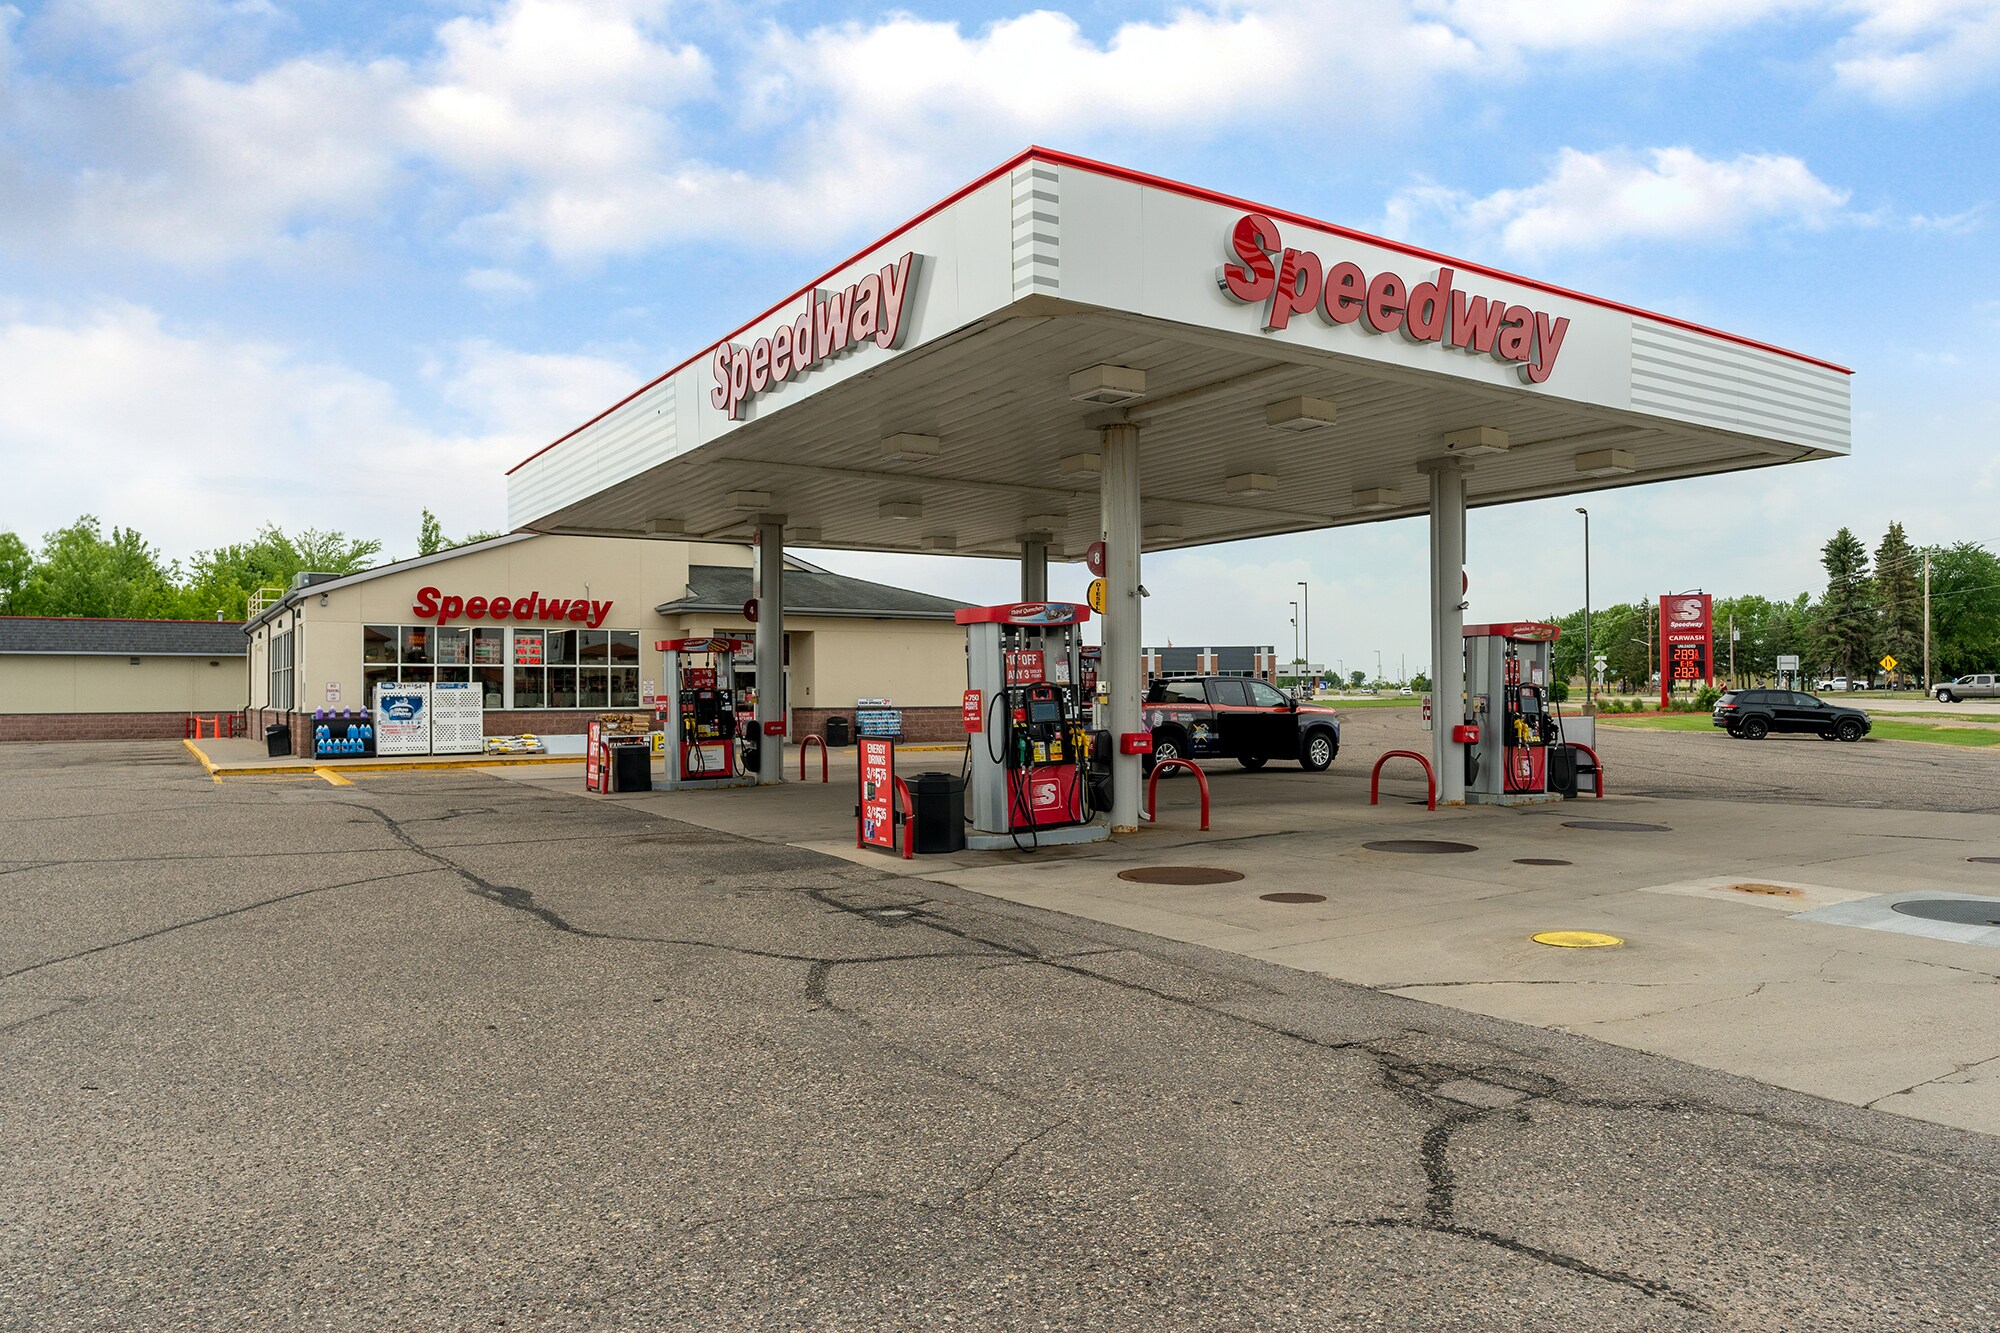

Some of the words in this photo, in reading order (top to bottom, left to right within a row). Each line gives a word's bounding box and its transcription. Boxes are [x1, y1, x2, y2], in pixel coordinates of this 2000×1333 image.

[1218, 213, 1571, 385] Speedway
[710, 251, 918, 421] Speedway
[1094, 552, 1100, 565] 8
[412, 586, 614, 629] Speedway
[1021, 653, 1037, 665] OFF
[1024, 669, 1030, 679] 3
[722, 692, 729, 700] 4
[1541, 689, 1547, 698] 6
[590, 742, 599, 756] OFF
[867, 744, 886, 755] ENERGY
[868, 755, 886, 766] DRINKS
